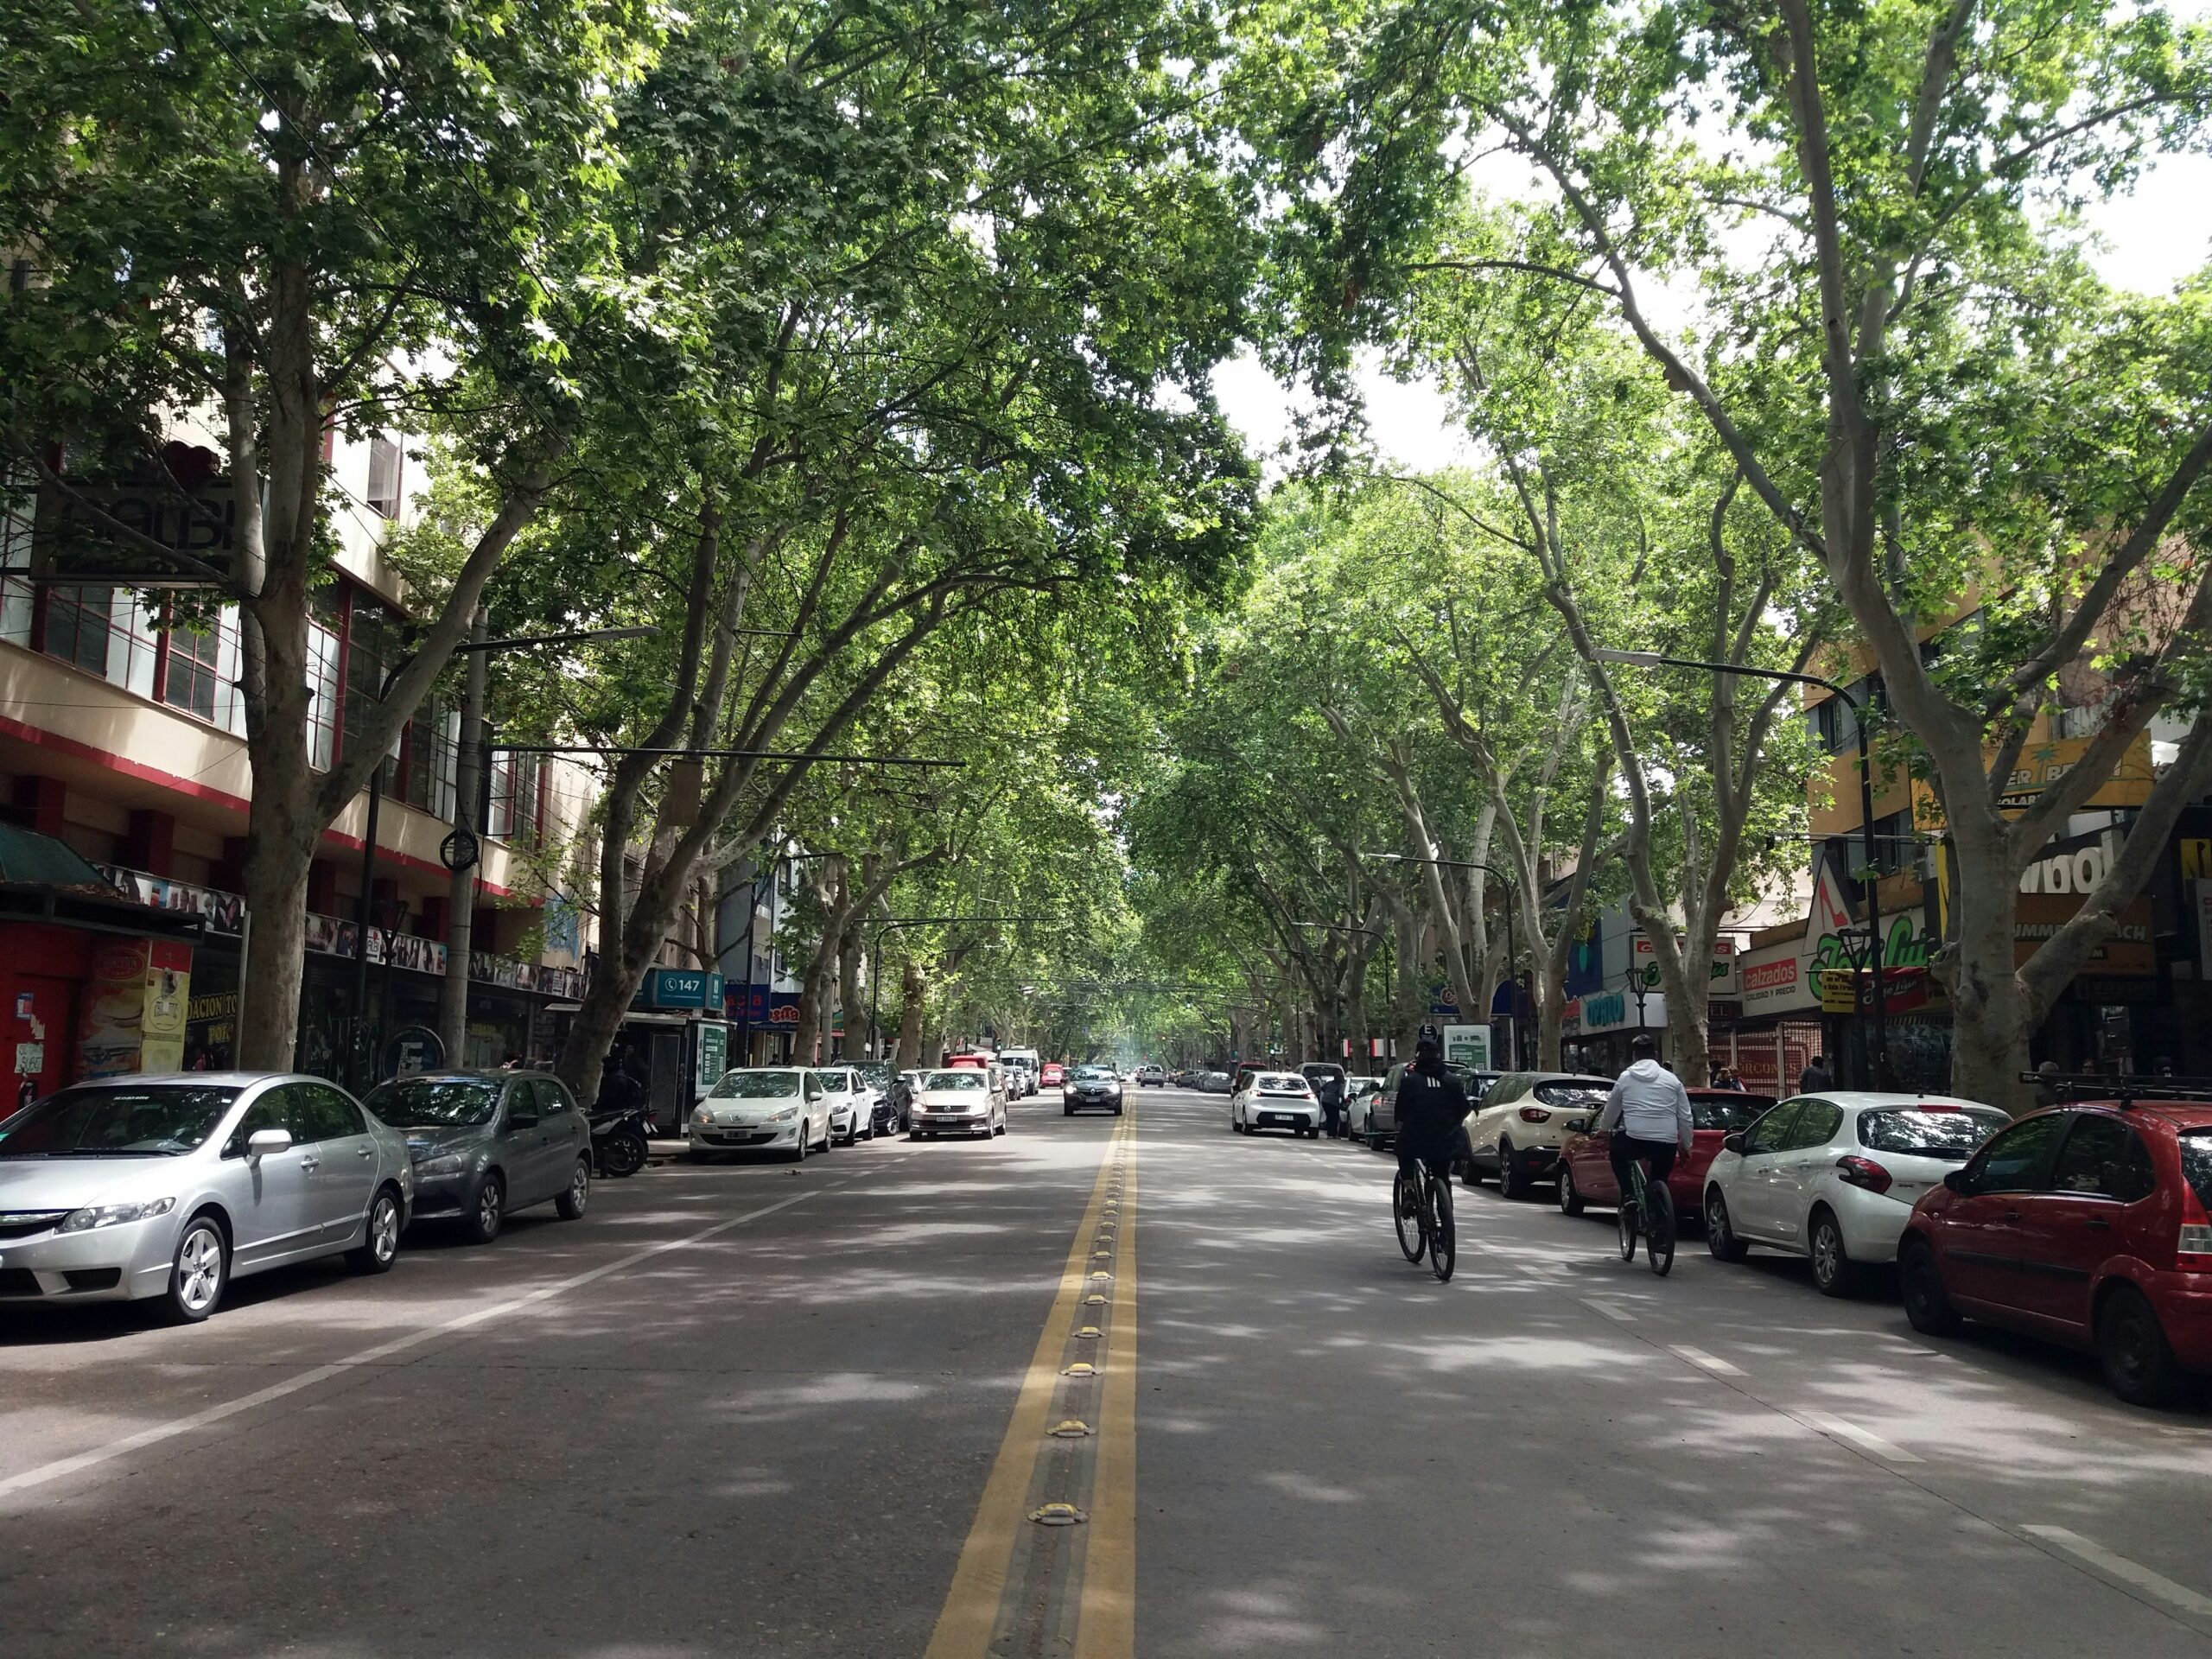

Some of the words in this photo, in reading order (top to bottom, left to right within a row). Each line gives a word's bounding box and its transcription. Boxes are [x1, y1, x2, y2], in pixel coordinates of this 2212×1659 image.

[1745, 963, 1796, 988] calzados
[678, 979, 700, 992] 147
[1745, 990, 1769, 1001] CALIDAD
[1775, 985, 1796, 996] PRECIO
[1424, 1024, 1432, 1034] E
